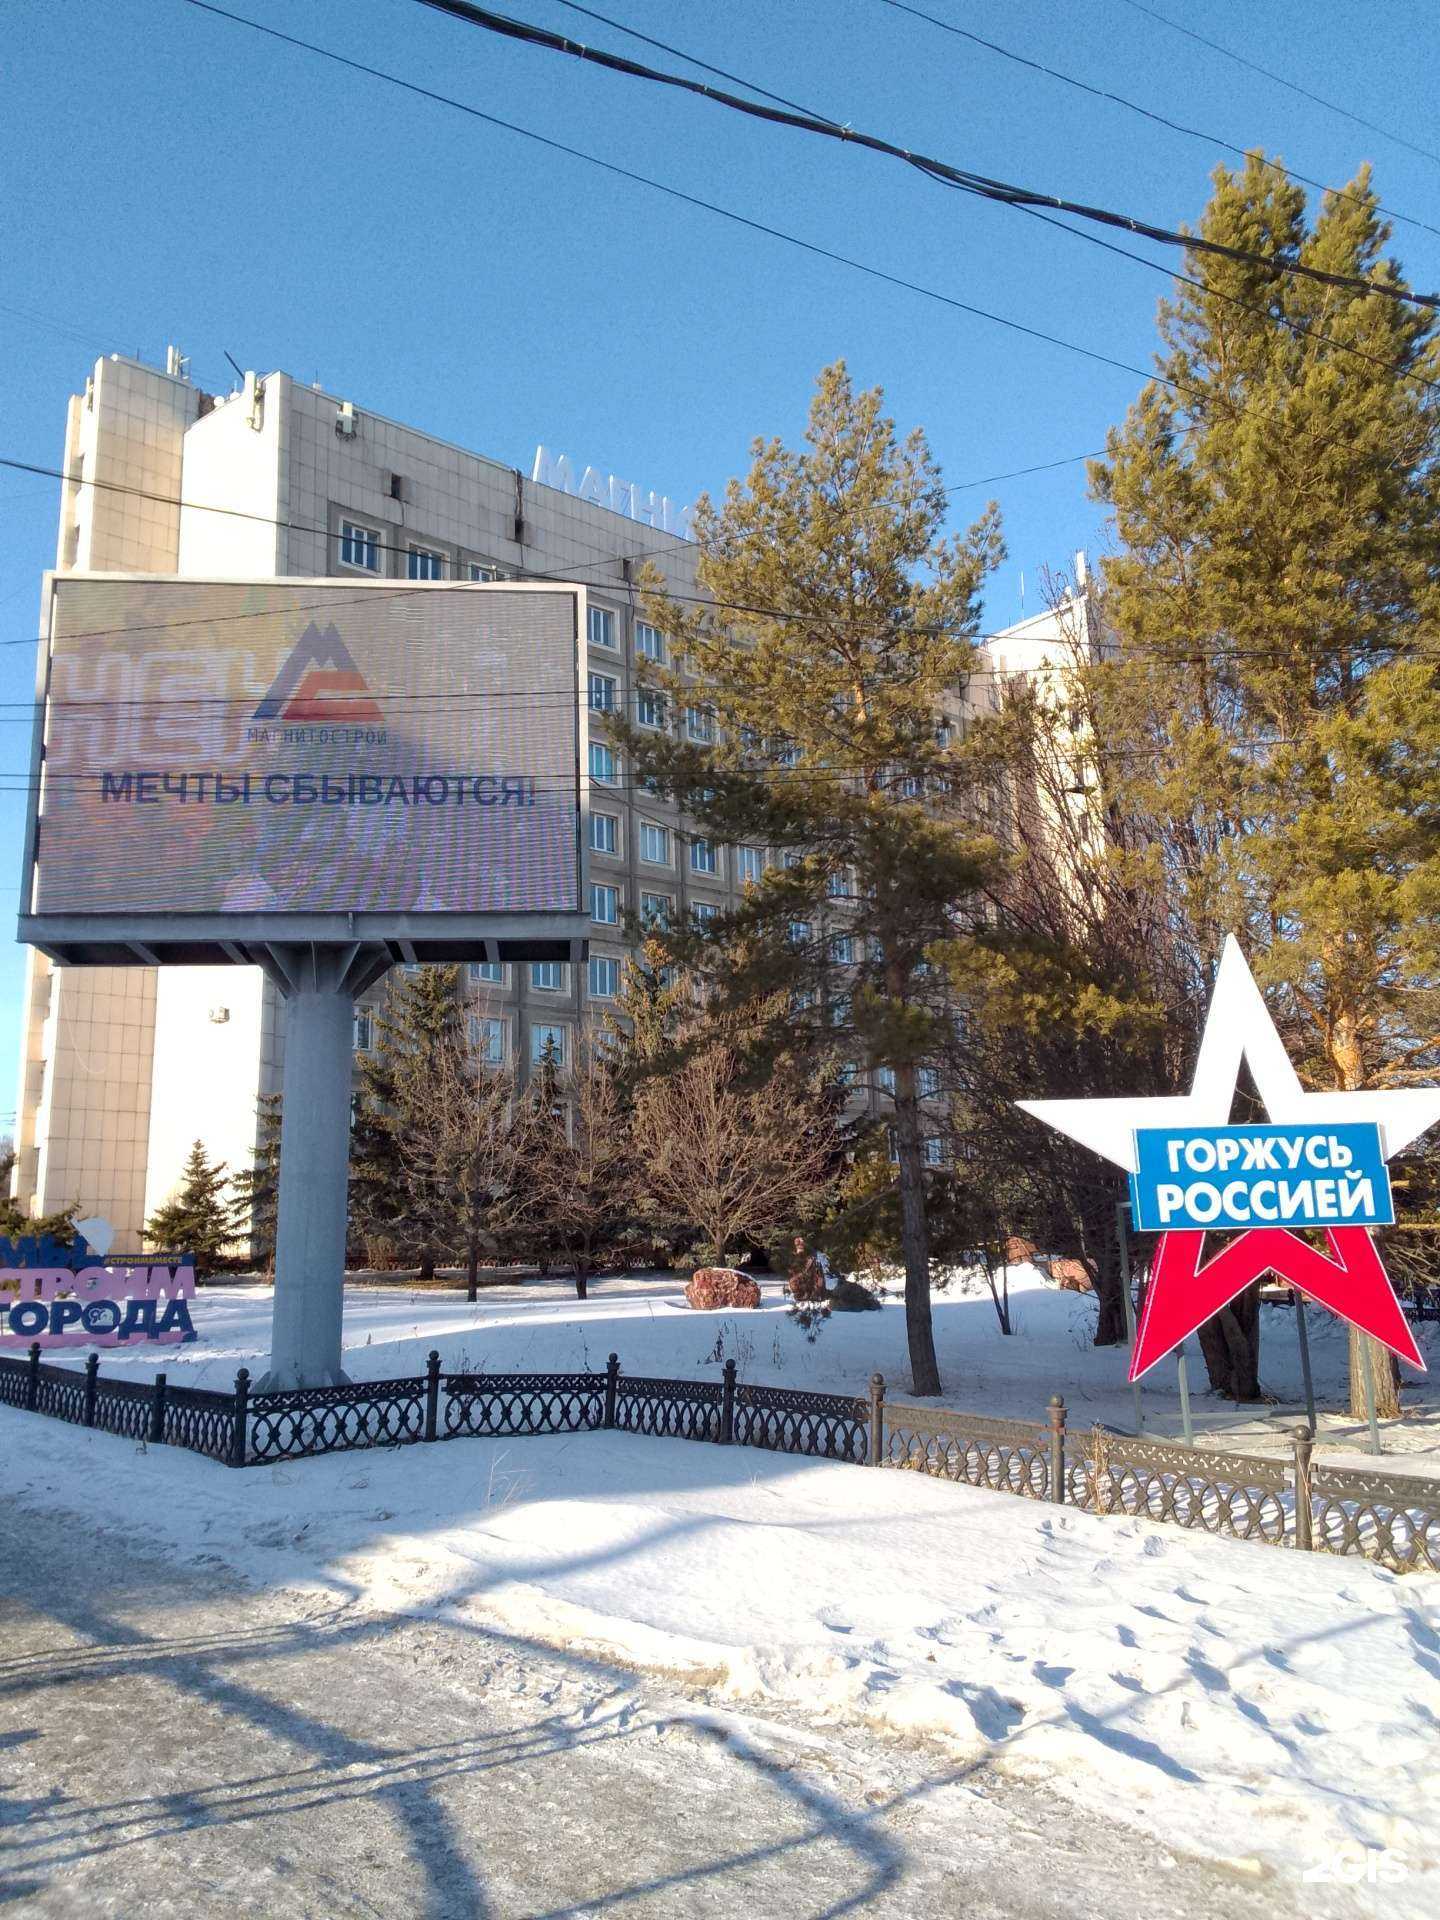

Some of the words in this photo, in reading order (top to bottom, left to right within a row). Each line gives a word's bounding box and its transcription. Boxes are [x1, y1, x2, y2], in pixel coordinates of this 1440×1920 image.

[101, 771, 249, 803] МЕЧТЫ
[264, 773, 536, 806] СБЫВАЮТСЯ!
[1167, 1135, 1353, 1173] ГОРЖУСЬ
[1156, 1169, 1376, 1223] РОССИЕЙ
